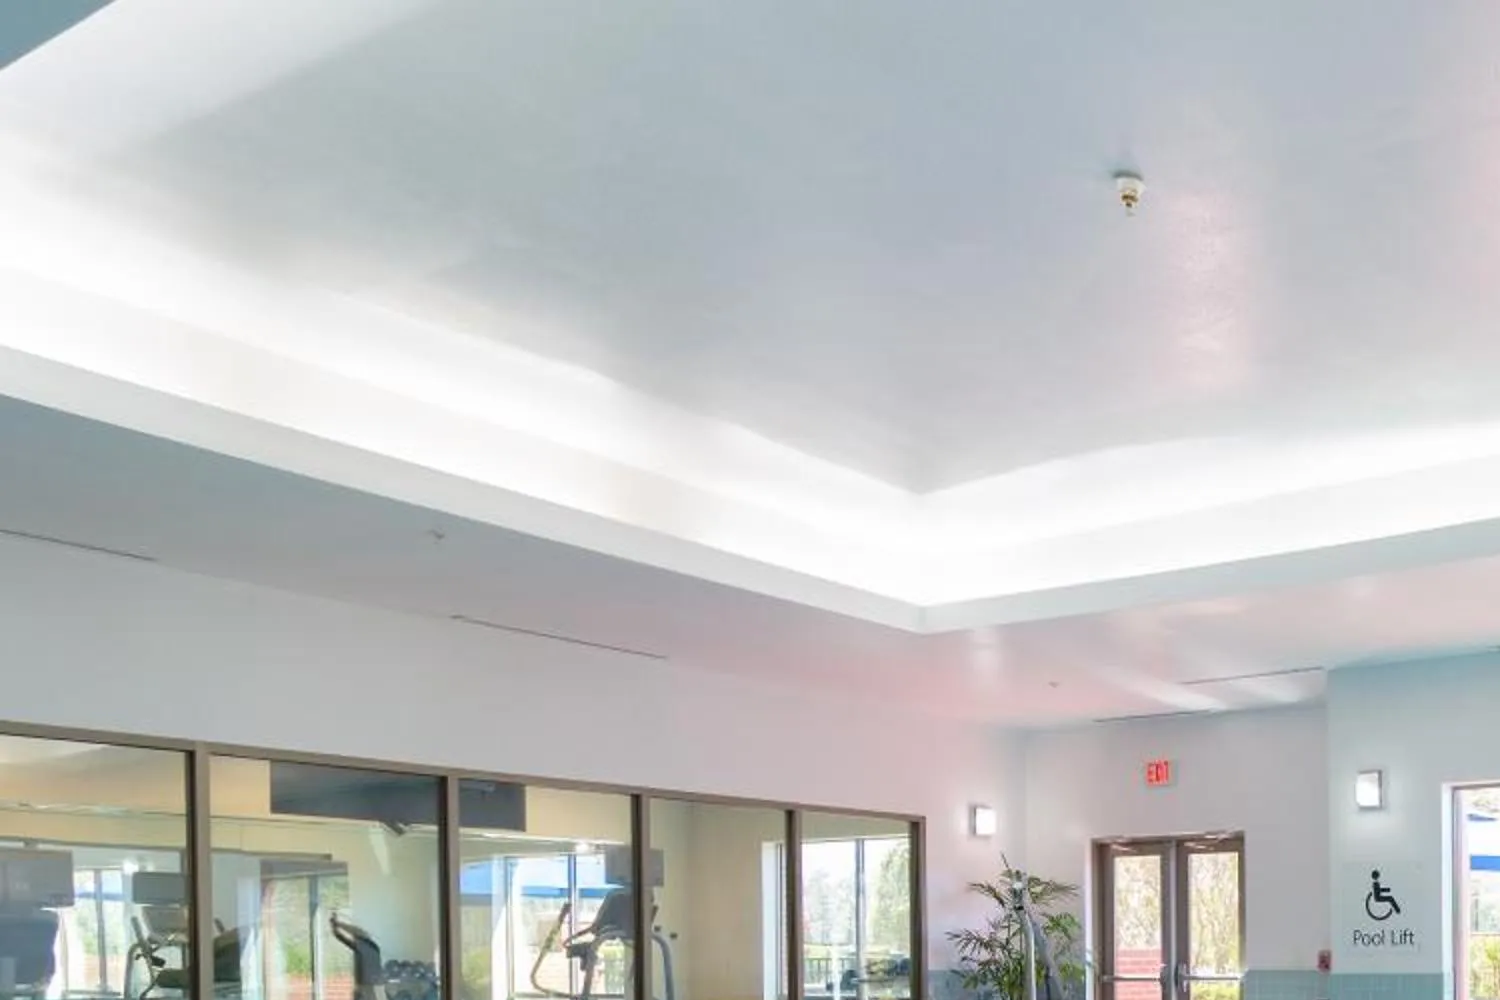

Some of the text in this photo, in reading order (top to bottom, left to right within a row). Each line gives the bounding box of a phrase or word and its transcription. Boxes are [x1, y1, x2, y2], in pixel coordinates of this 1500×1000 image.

[1147, 761, 1169, 782] EXIT
[1353, 928, 1415, 946] Pool Lift
